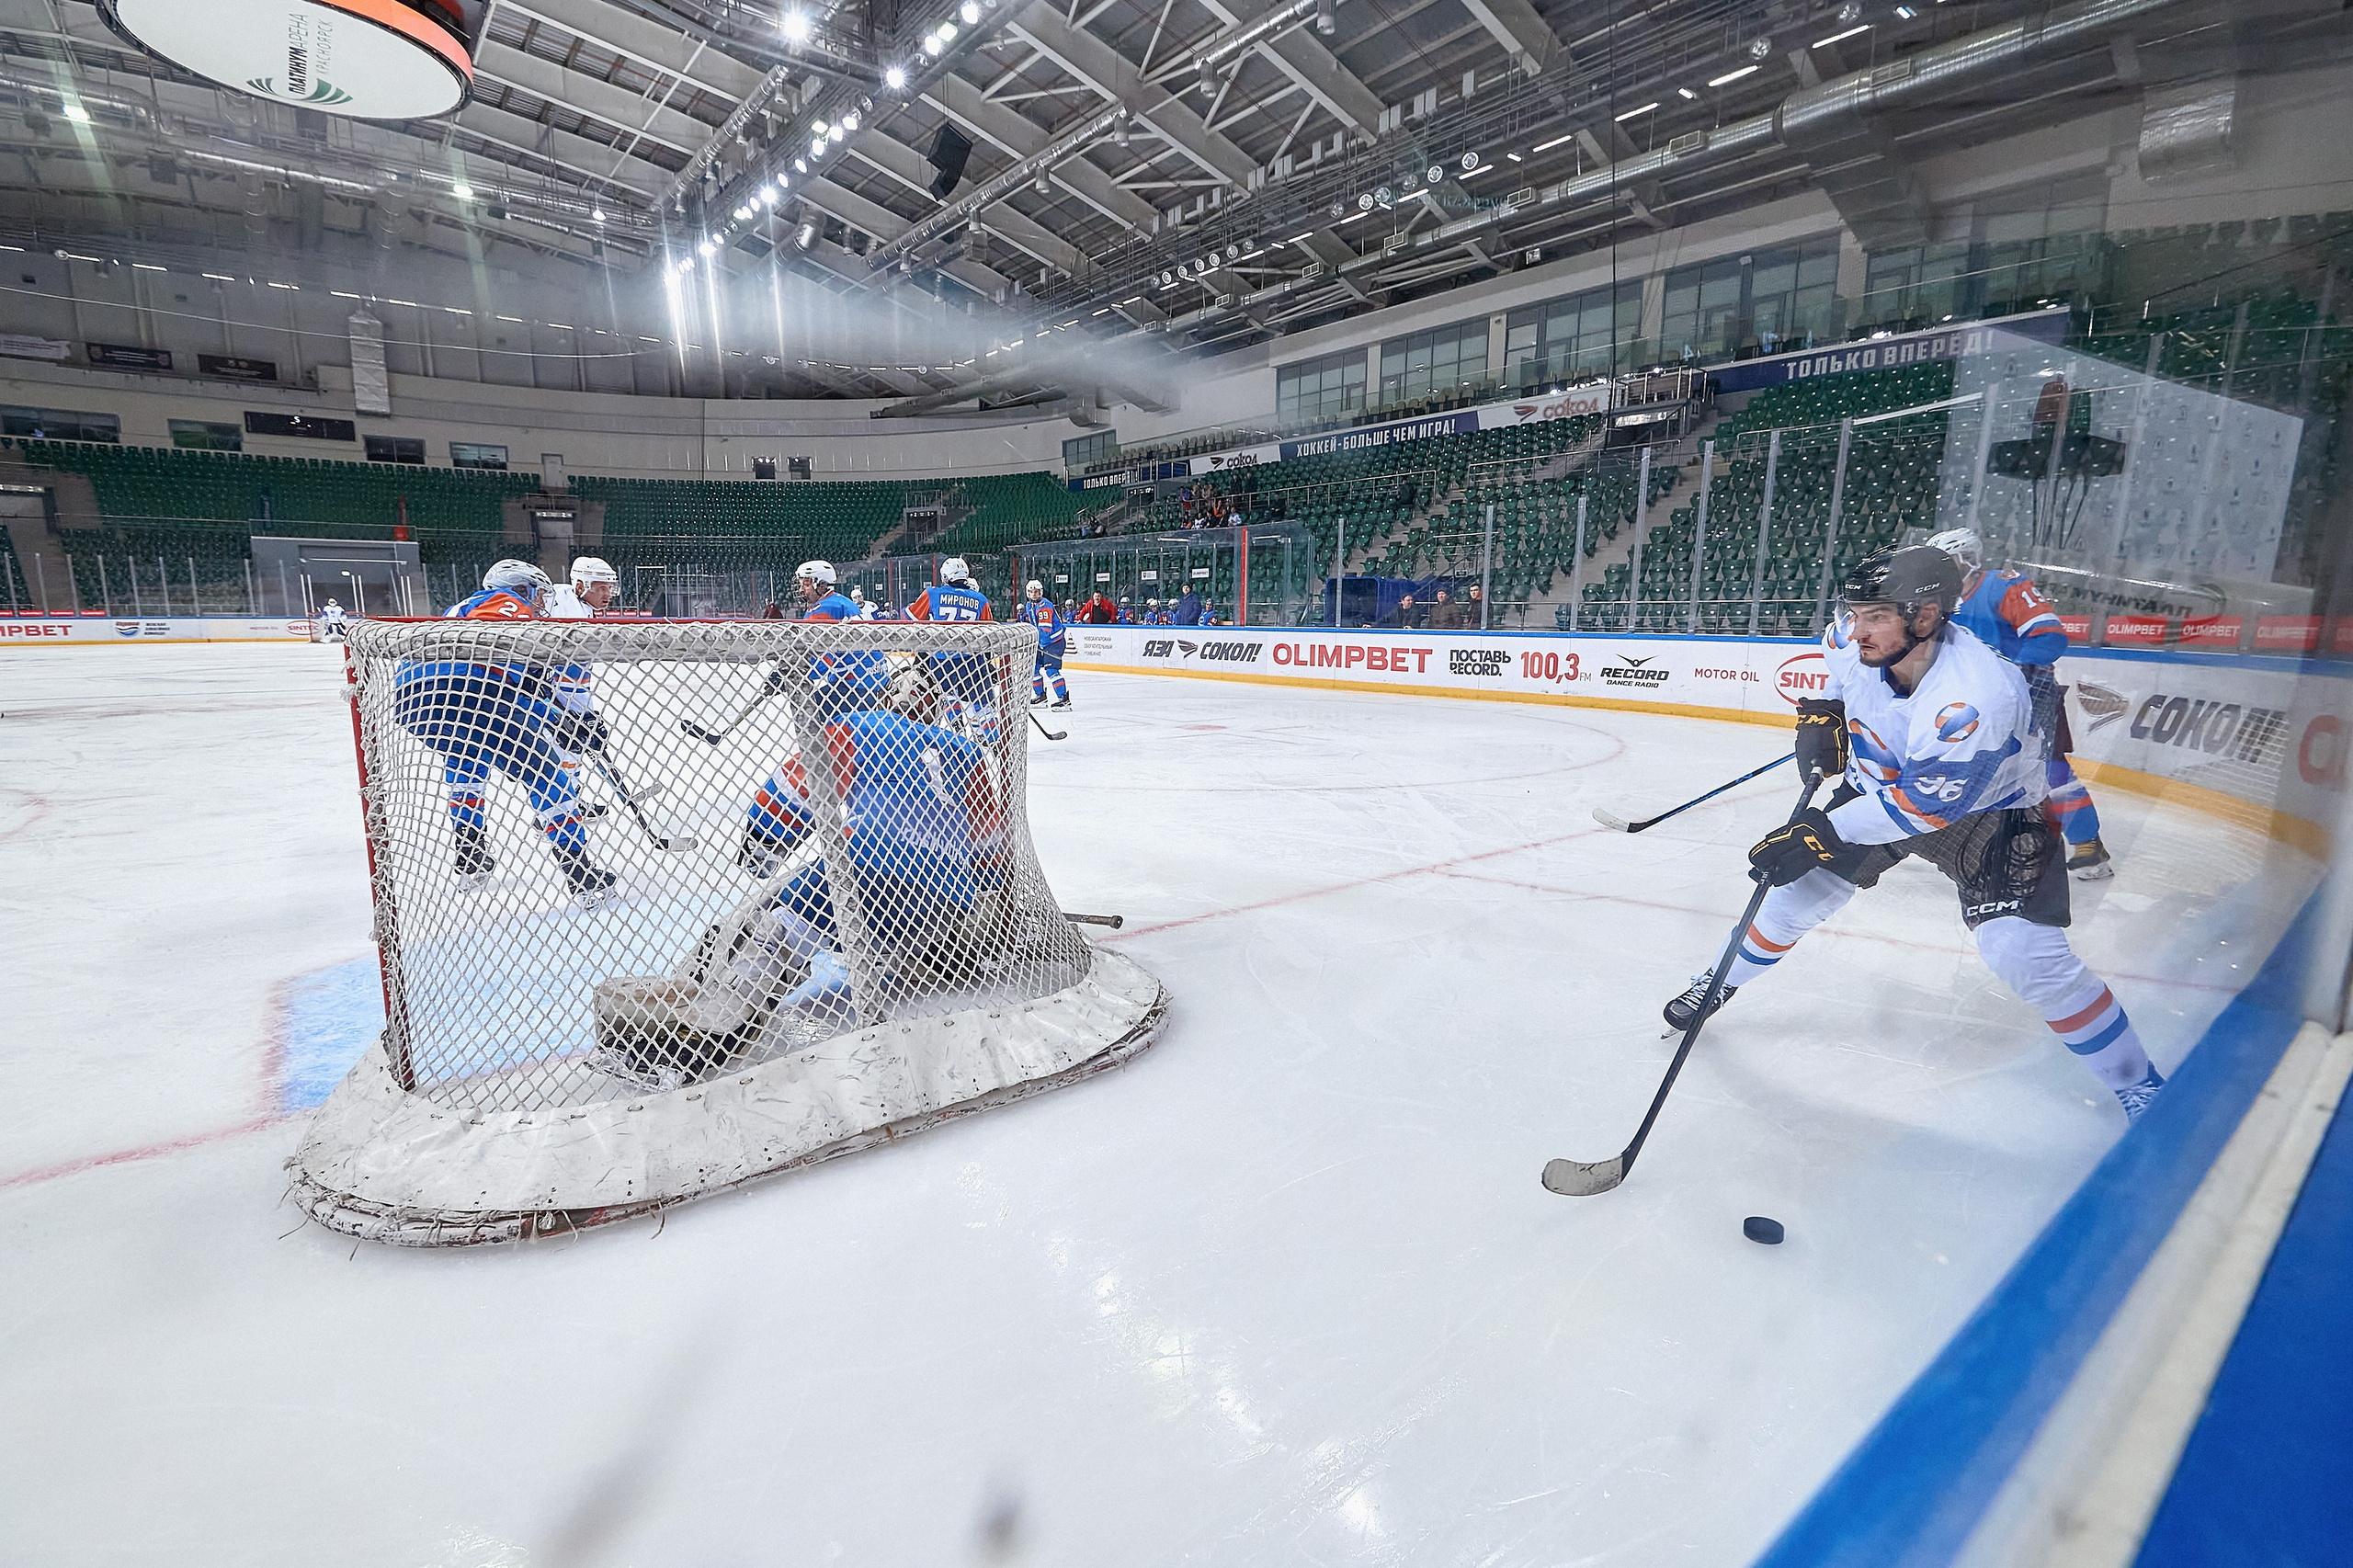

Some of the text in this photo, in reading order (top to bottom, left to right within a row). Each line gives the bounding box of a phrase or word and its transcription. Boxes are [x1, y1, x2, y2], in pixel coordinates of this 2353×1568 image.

[1786, 329, 1994, 380] ТОЛЬКО ВПЕРЁД!
[1392, 426, 1416, 442] ЧЕМ
[1419, 418, 1456, 438] ИГРА!
[1083, 475, 1108, 490] ТОЛЬКО
[1915, 583, 1940, 594] CCM
[939, 594, 980, 610] МИРОНОВ
[1038, 611, 1049, 620] 99
[2108, 624, 2165, 635] OLIMPBET
[2183, 624, 2240, 638] OLIMPBET
[1199, 642, 1263, 663] СОКОЛ!
[1273, 642, 1433, 673] OLIMPBET
[1449, 649, 1511, 663] ПОСТАВЬ
[1579, 672, 1592, 683] FM
[1600, 667, 1670, 682] RECORD
[1694, 668, 1760, 682] MOTOR OIL
[1779, 672, 1830, 691] SINT
[1607, 679, 1633, 687] DANCE
[1797, 714, 1830, 724] CM
[1803, 834, 1835, 861] CC
[1966, 900, 2019, 917] CCM
